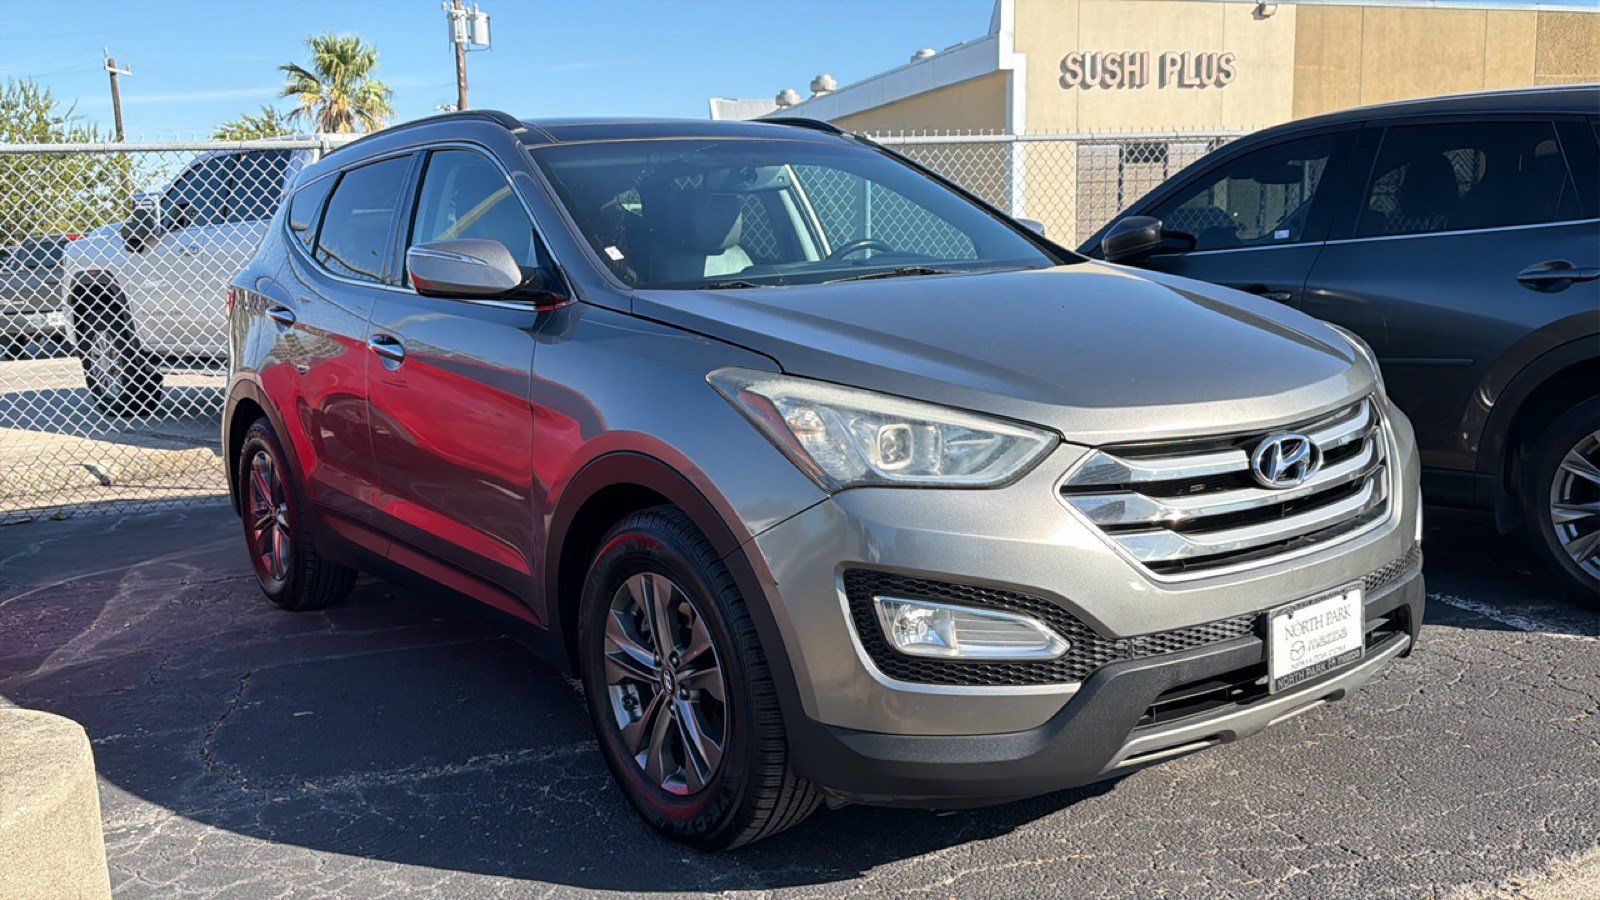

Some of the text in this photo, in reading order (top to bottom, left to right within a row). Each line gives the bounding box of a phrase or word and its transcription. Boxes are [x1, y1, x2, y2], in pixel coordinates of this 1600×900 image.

[1059, 50, 1237, 90] SUSHI PLUS
[1284, 603, 1351, 641] NORTH PARK
[1278, 667, 1304, 689] NORTH
[1305, 660, 1326, 677] PARK
